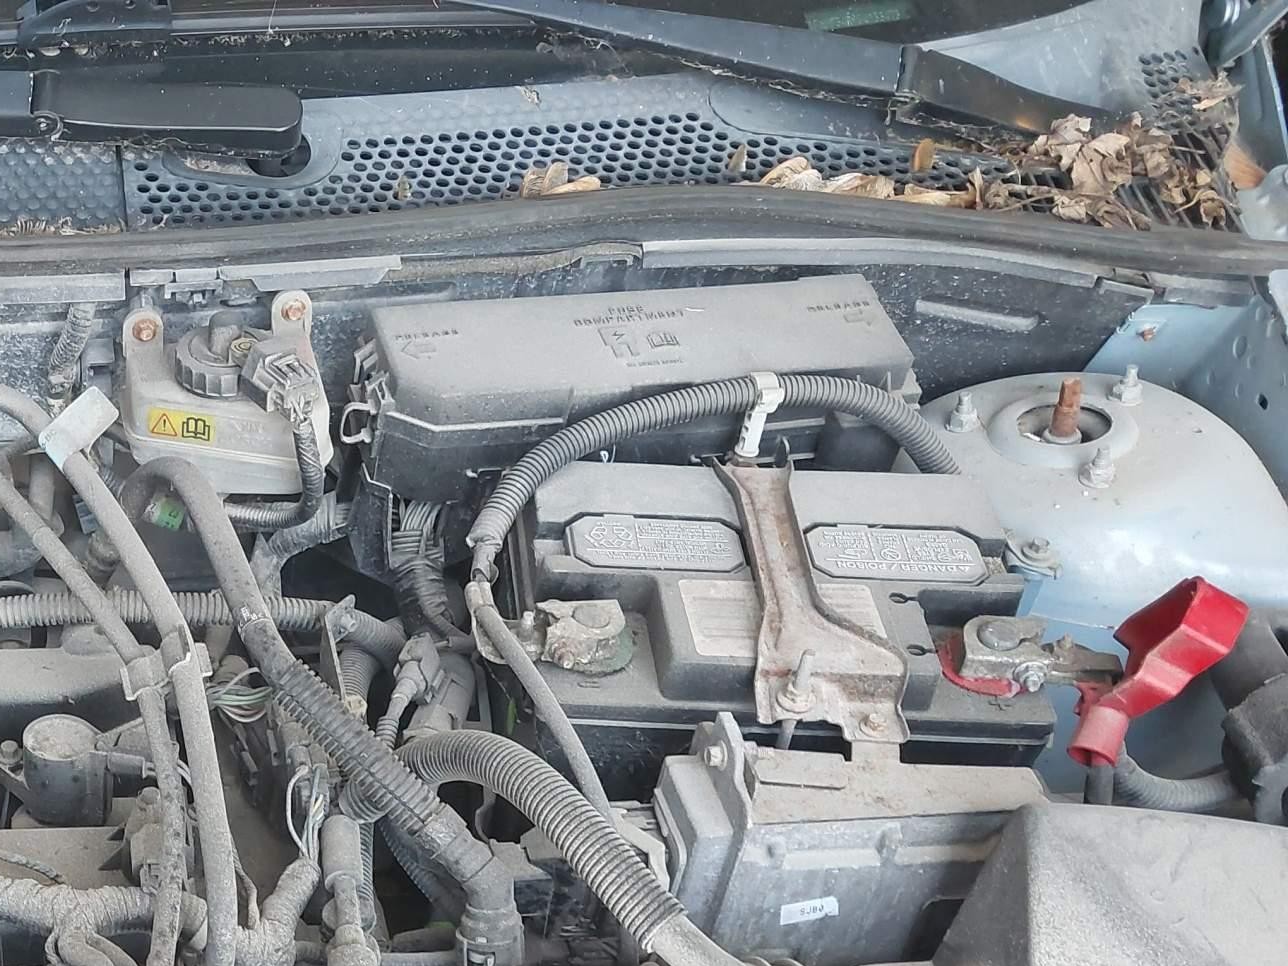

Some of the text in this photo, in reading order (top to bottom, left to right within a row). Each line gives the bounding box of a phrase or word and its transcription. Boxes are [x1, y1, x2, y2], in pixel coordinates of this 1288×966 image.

[607, 304, 645, 316] FUSE
[572, 309, 684, 327] COMPARTMENT
[901, 562, 959, 573] DANGER
